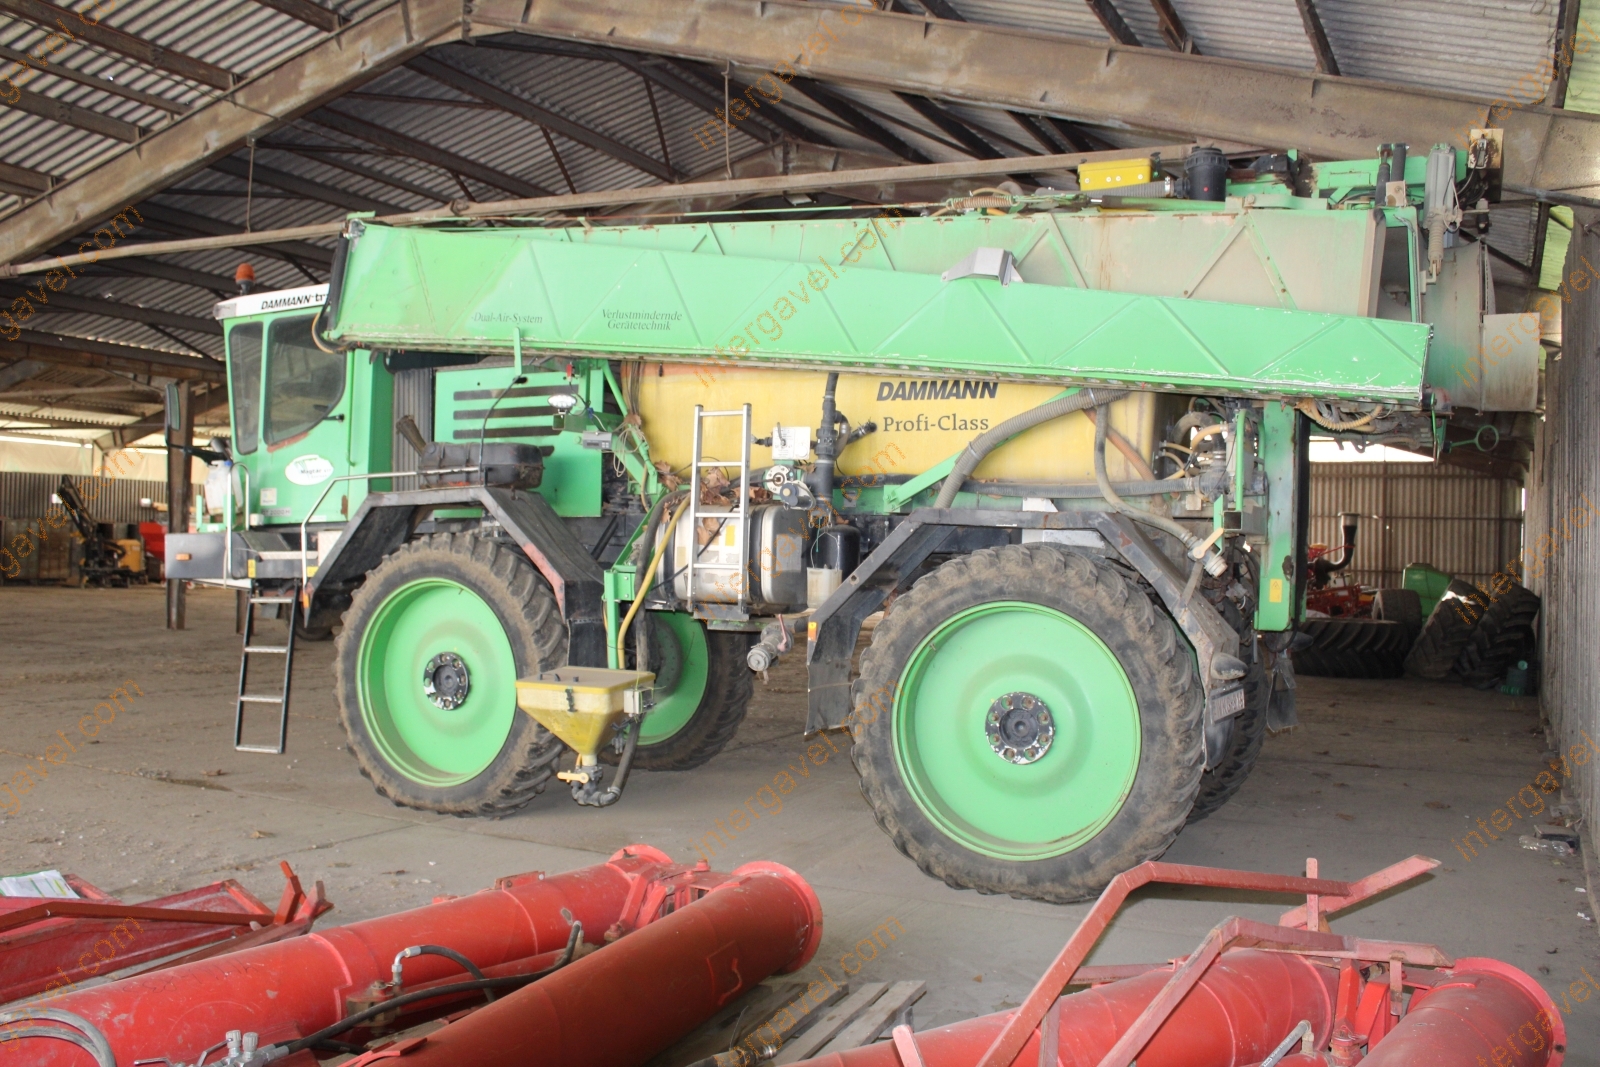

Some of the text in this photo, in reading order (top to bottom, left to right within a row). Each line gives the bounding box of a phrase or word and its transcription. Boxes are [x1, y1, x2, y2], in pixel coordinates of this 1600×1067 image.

[602, 309, 682, 321] Verlustmindernde
[607, 320, 671, 331] Gerätetechnik
[876, 380, 999, 401] DAMMANN
[883, 412, 989, 432] Profi-Class
